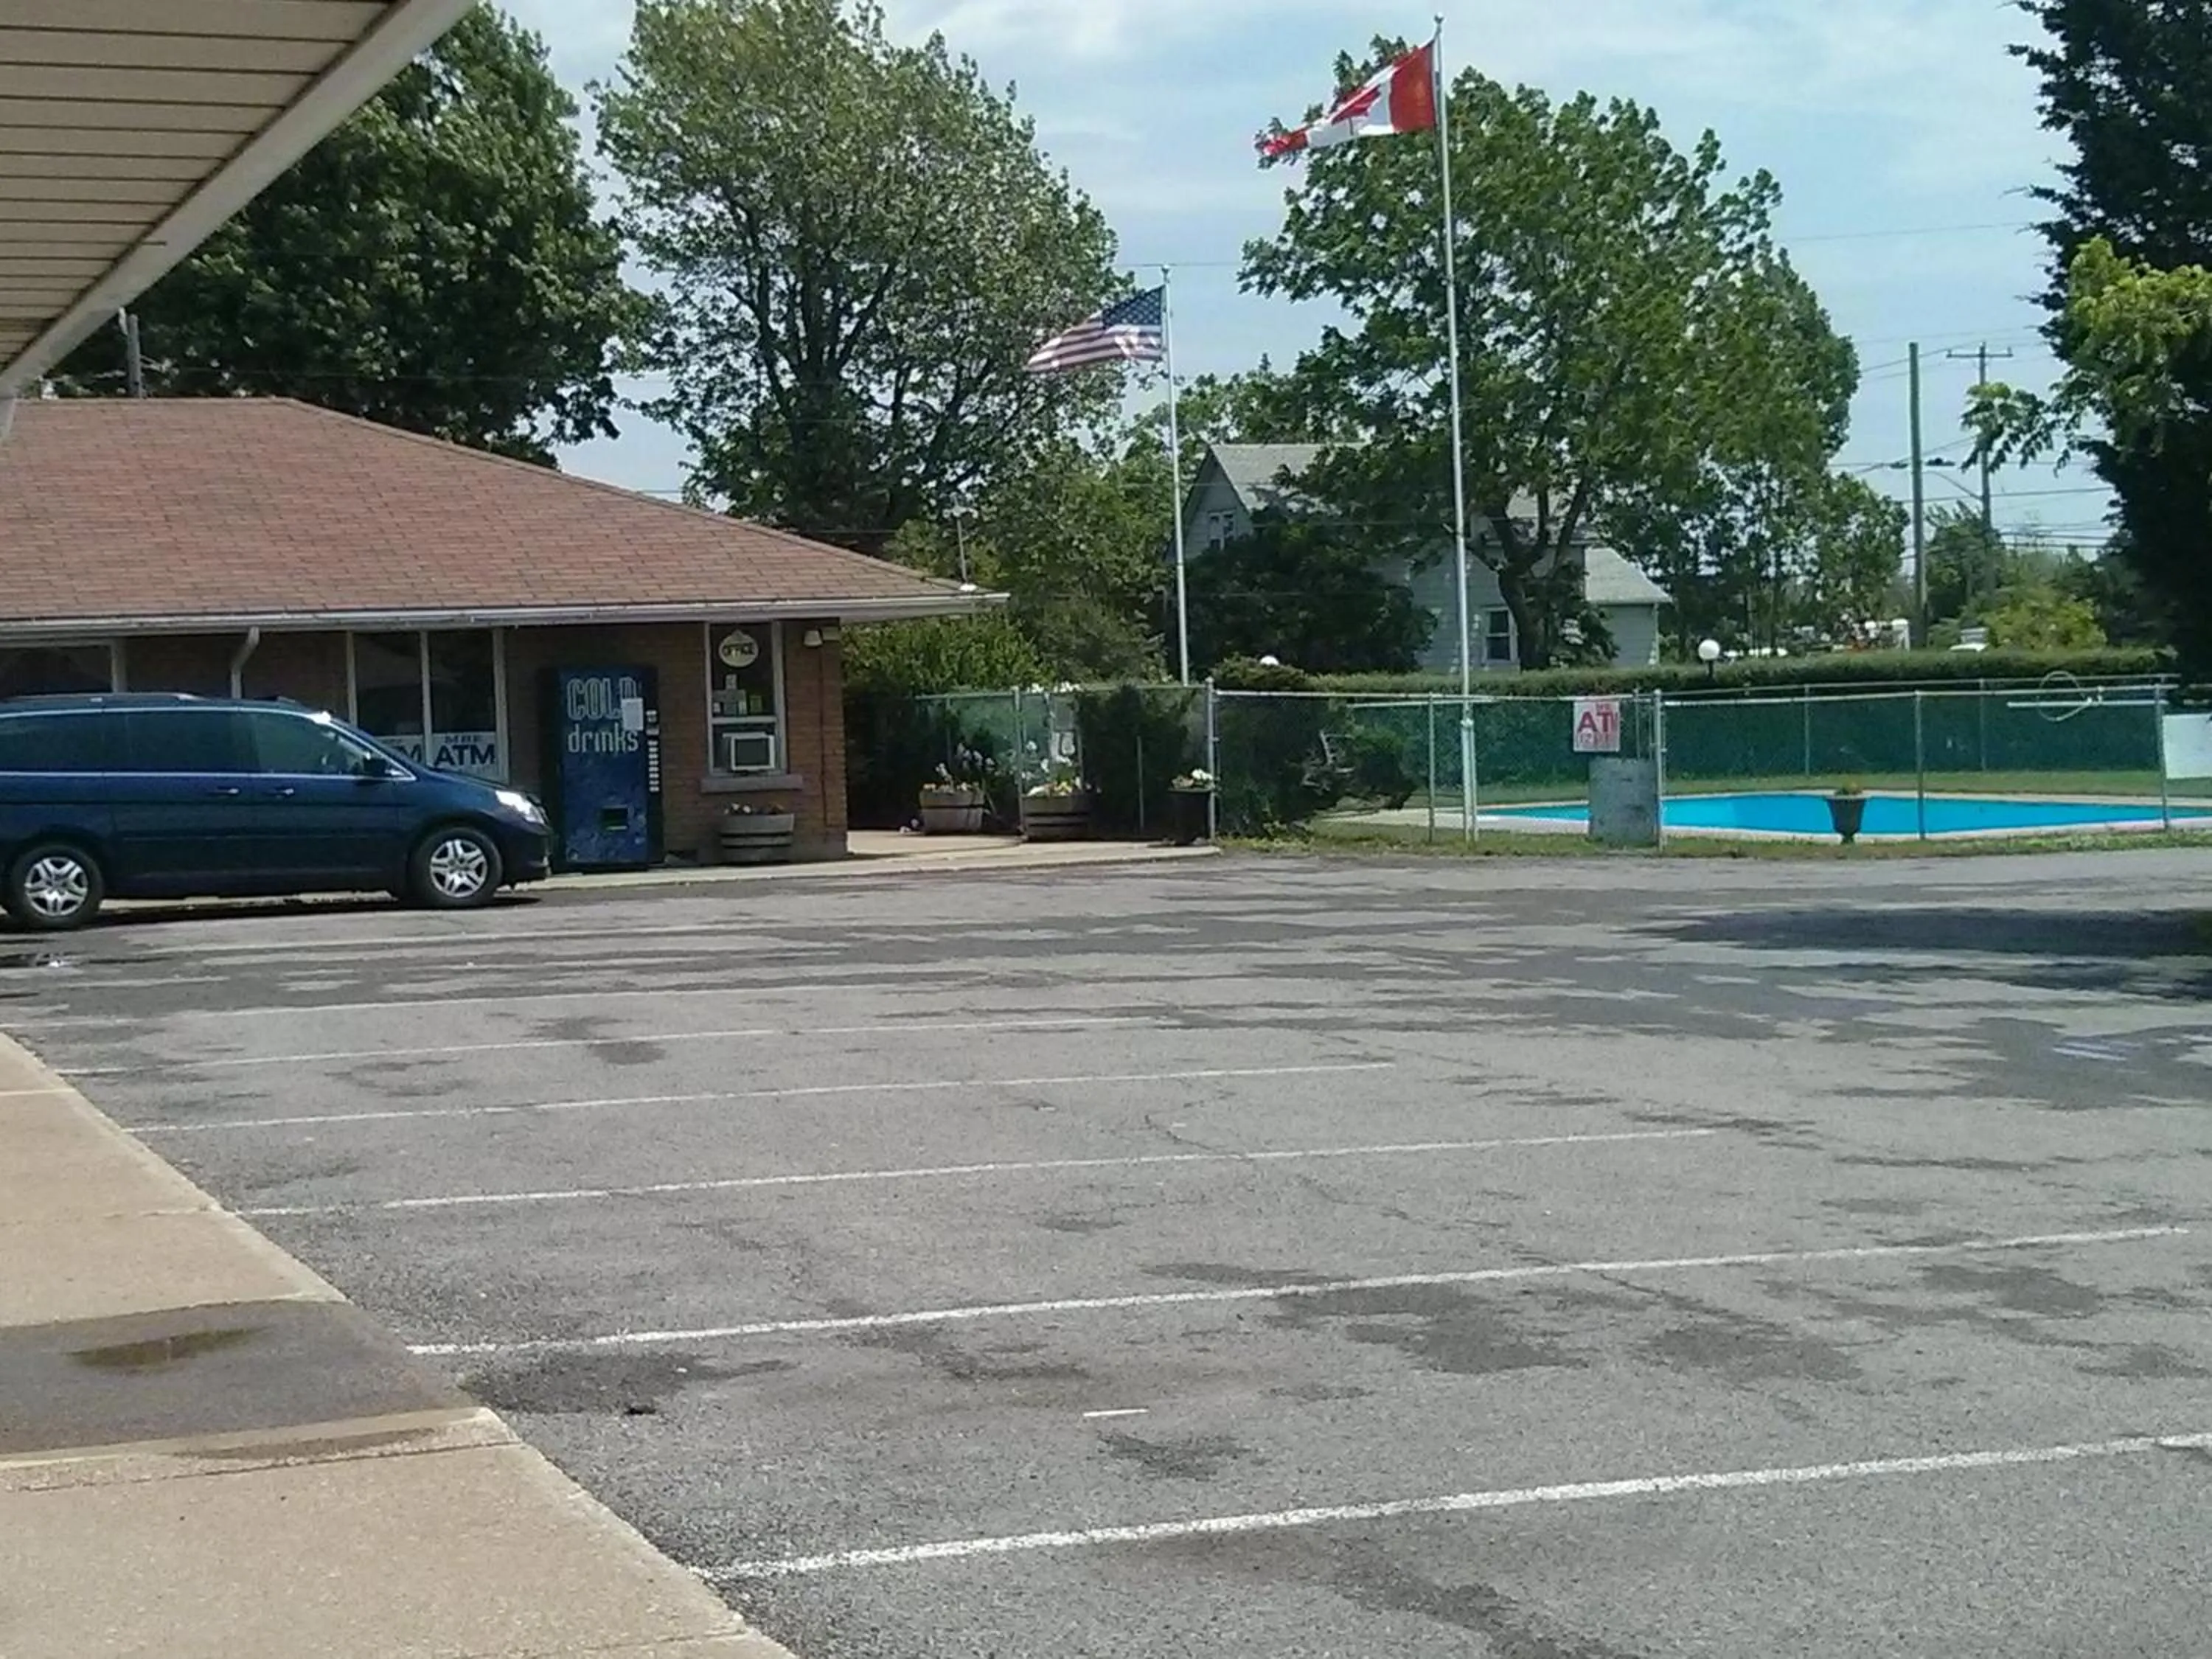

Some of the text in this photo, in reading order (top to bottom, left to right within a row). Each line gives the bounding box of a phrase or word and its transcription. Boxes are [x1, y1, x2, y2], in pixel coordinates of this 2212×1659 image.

[723, 642, 755, 657] OFFICE
[568, 722, 639, 754] drinks
[434, 744, 495, 767] ATM
